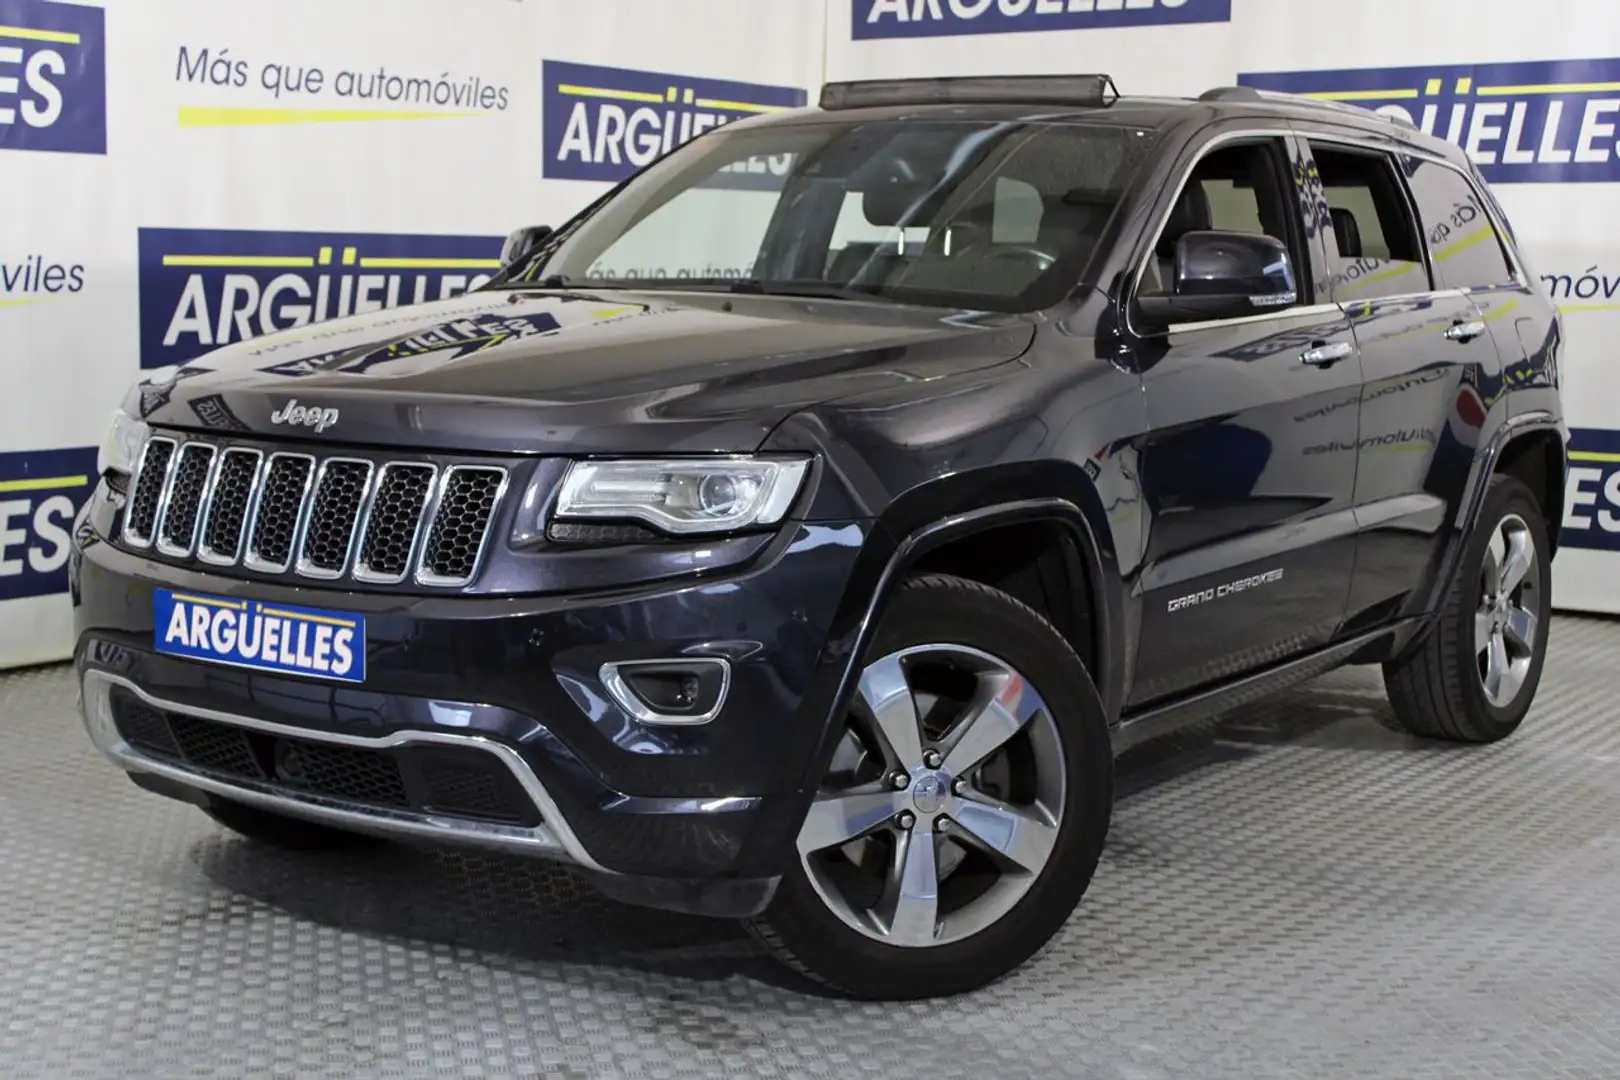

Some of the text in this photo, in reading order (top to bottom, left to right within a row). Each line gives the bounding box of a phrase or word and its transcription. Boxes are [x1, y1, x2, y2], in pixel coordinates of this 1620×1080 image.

[175, 46, 509, 111] Más que automóviles
[2, 255, 84, 293] viles
[271, 399, 339, 433] Jeep
[1168, 568, 1284, 612] GRAND CHEROKEE
[165, 600, 354, 675] ARGÜELLES
